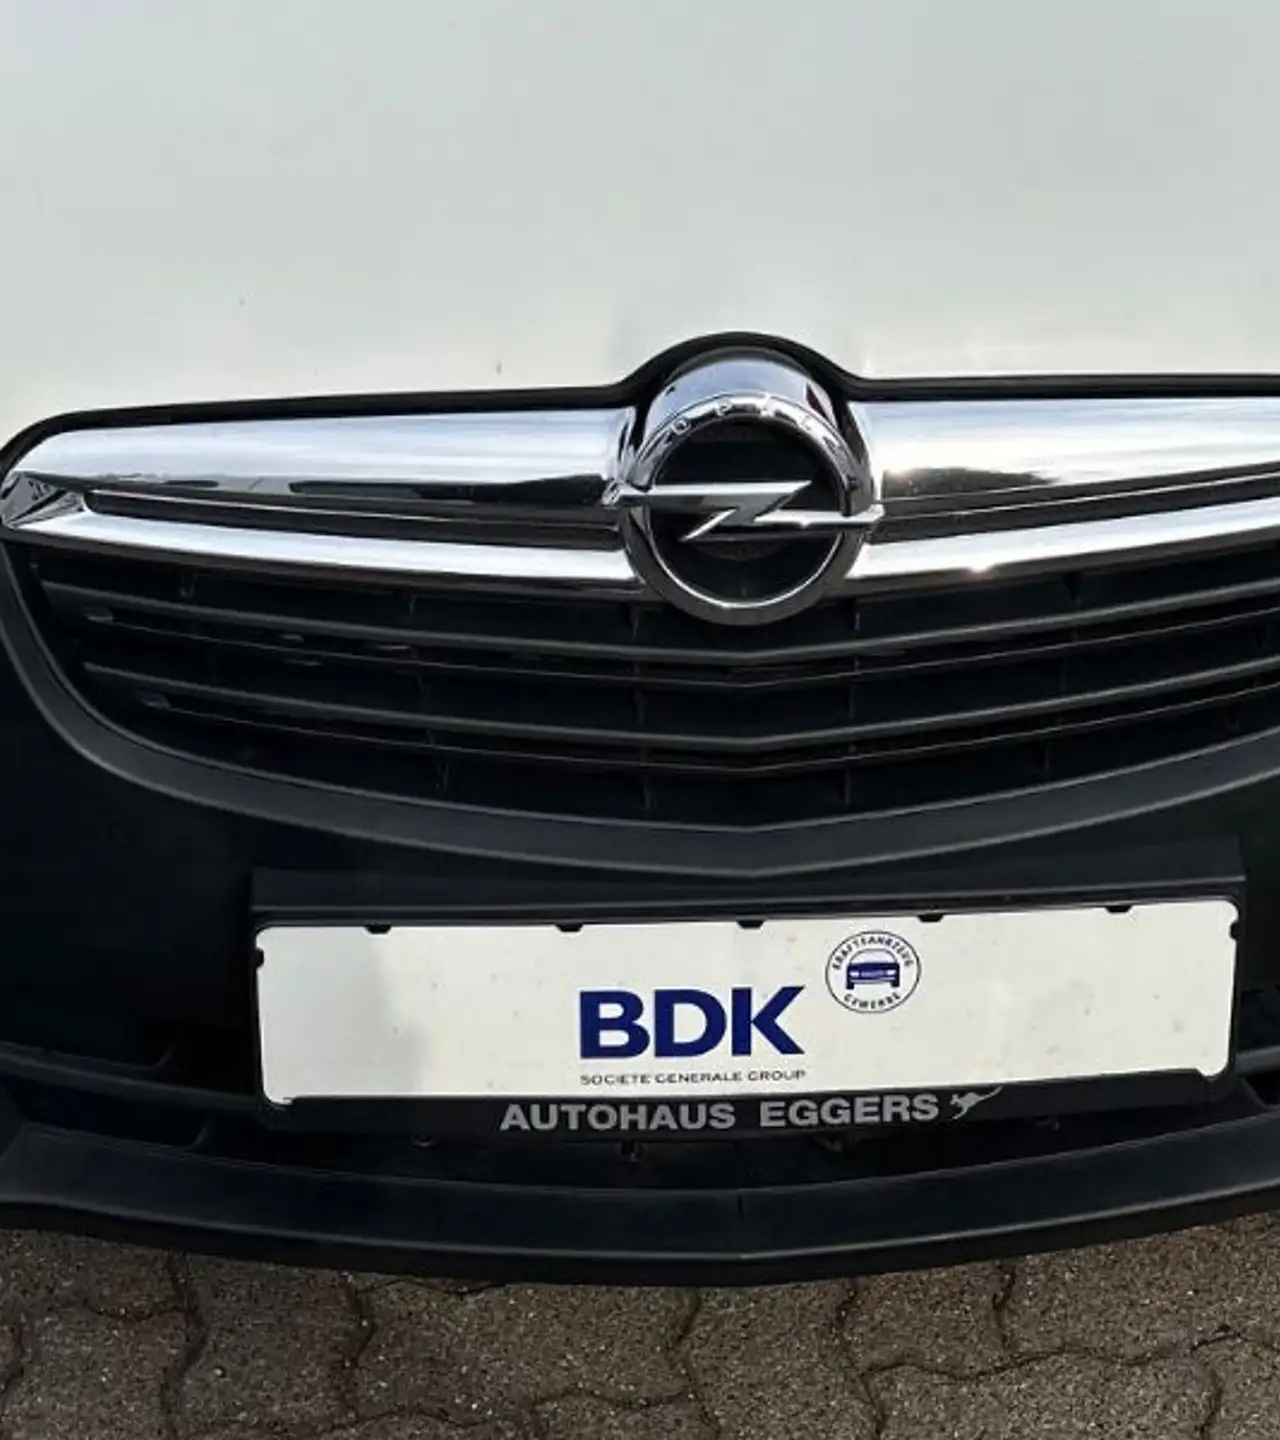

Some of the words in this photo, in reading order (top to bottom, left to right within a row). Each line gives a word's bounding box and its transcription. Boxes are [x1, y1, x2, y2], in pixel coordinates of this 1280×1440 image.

[580, 987, 805, 1059] BDK
[654, 1071, 742, 1085] GENERALE
[747, 1069, 807, 1082] GROUP
[500, 1103, 736, 1131] AUTOHAUS
[760, 1094, 940, 1128] EGGERS
